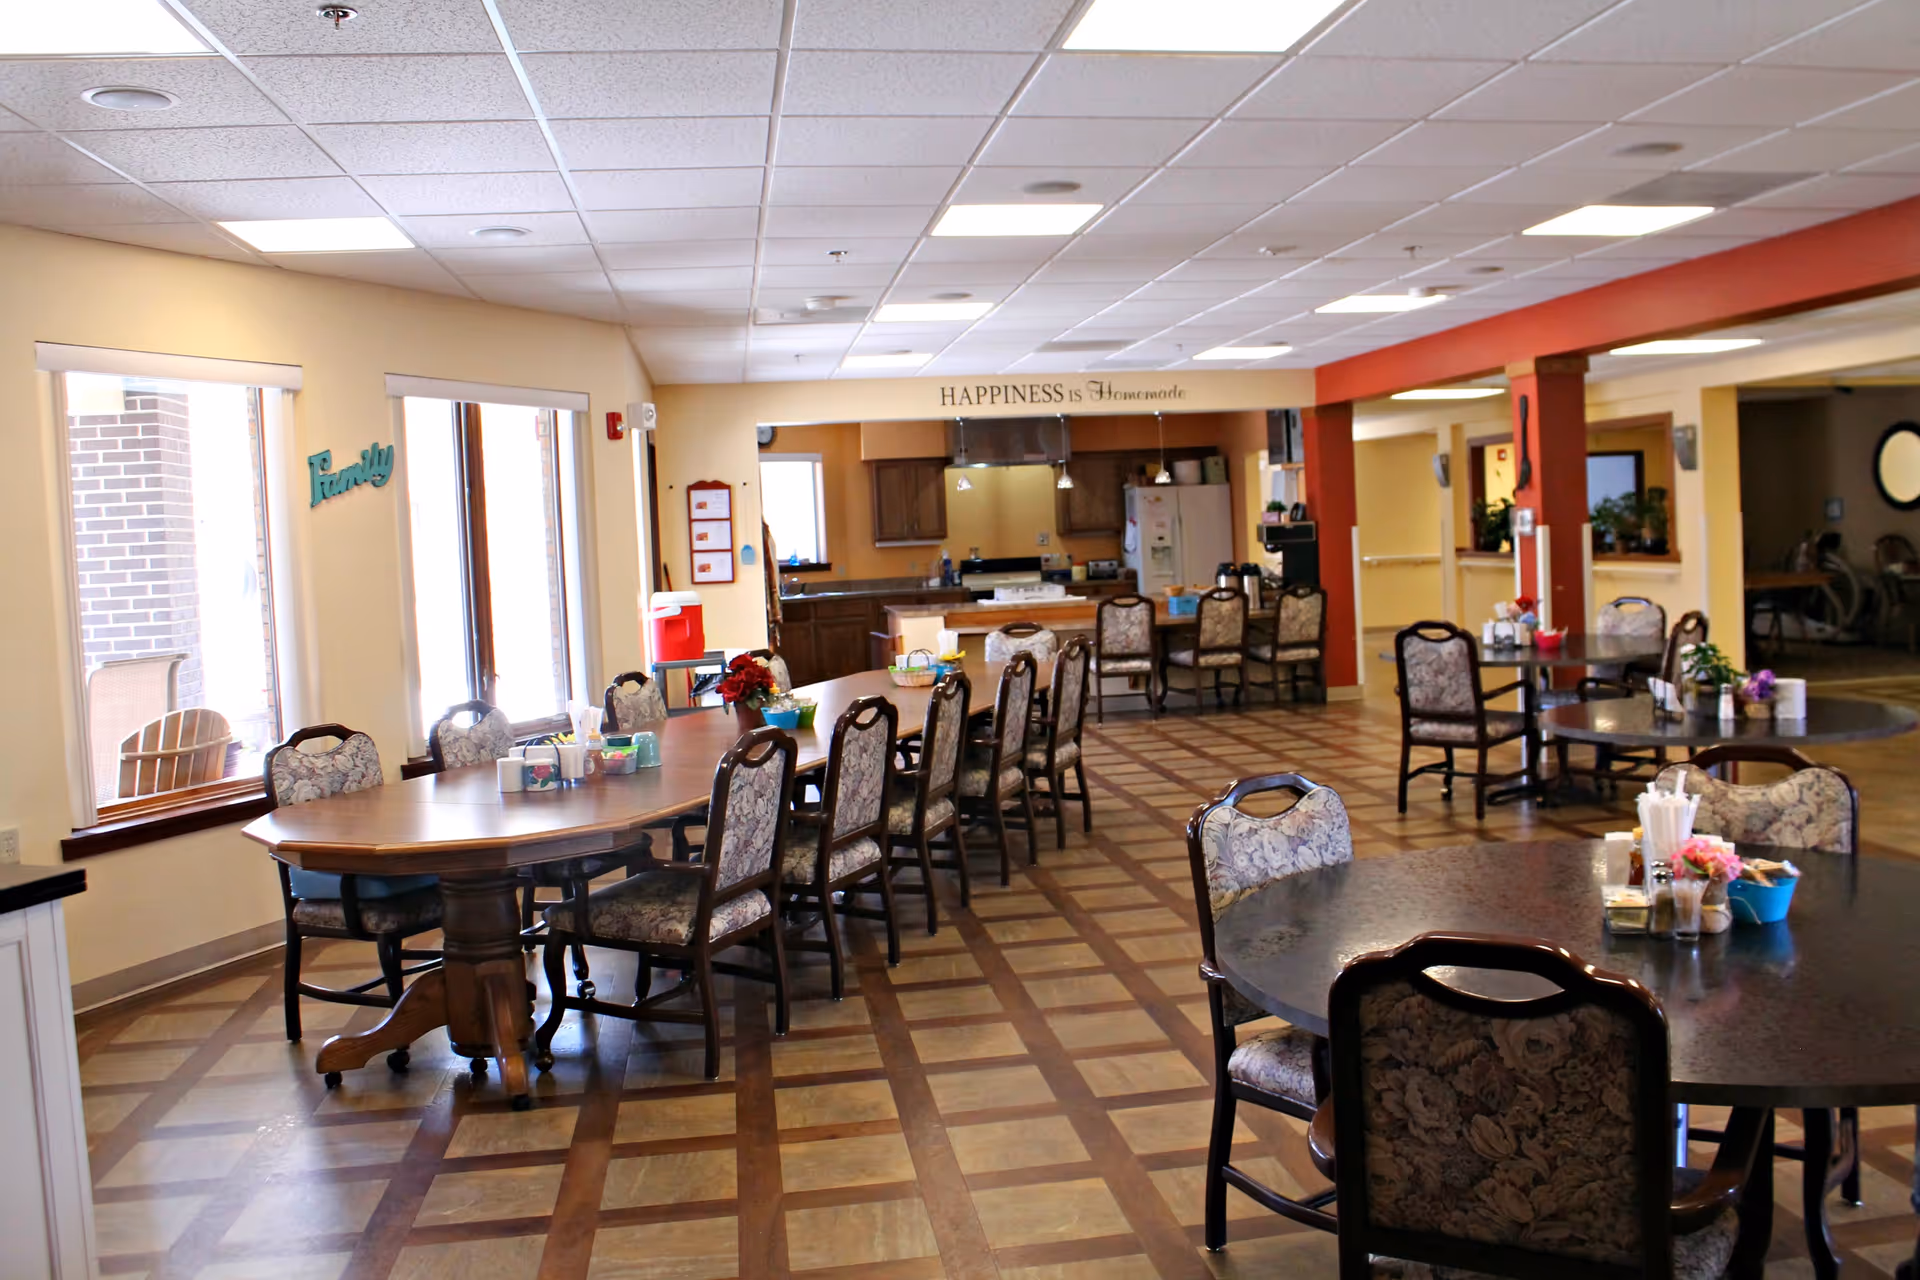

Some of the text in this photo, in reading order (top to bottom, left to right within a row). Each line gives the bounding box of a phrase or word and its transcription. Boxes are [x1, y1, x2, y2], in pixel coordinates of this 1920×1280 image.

[940, 383, 1064, 406] HAPPINESS
[1087, 380, 1186, 401] Homemade
[307, 441, 394, 508] Family
